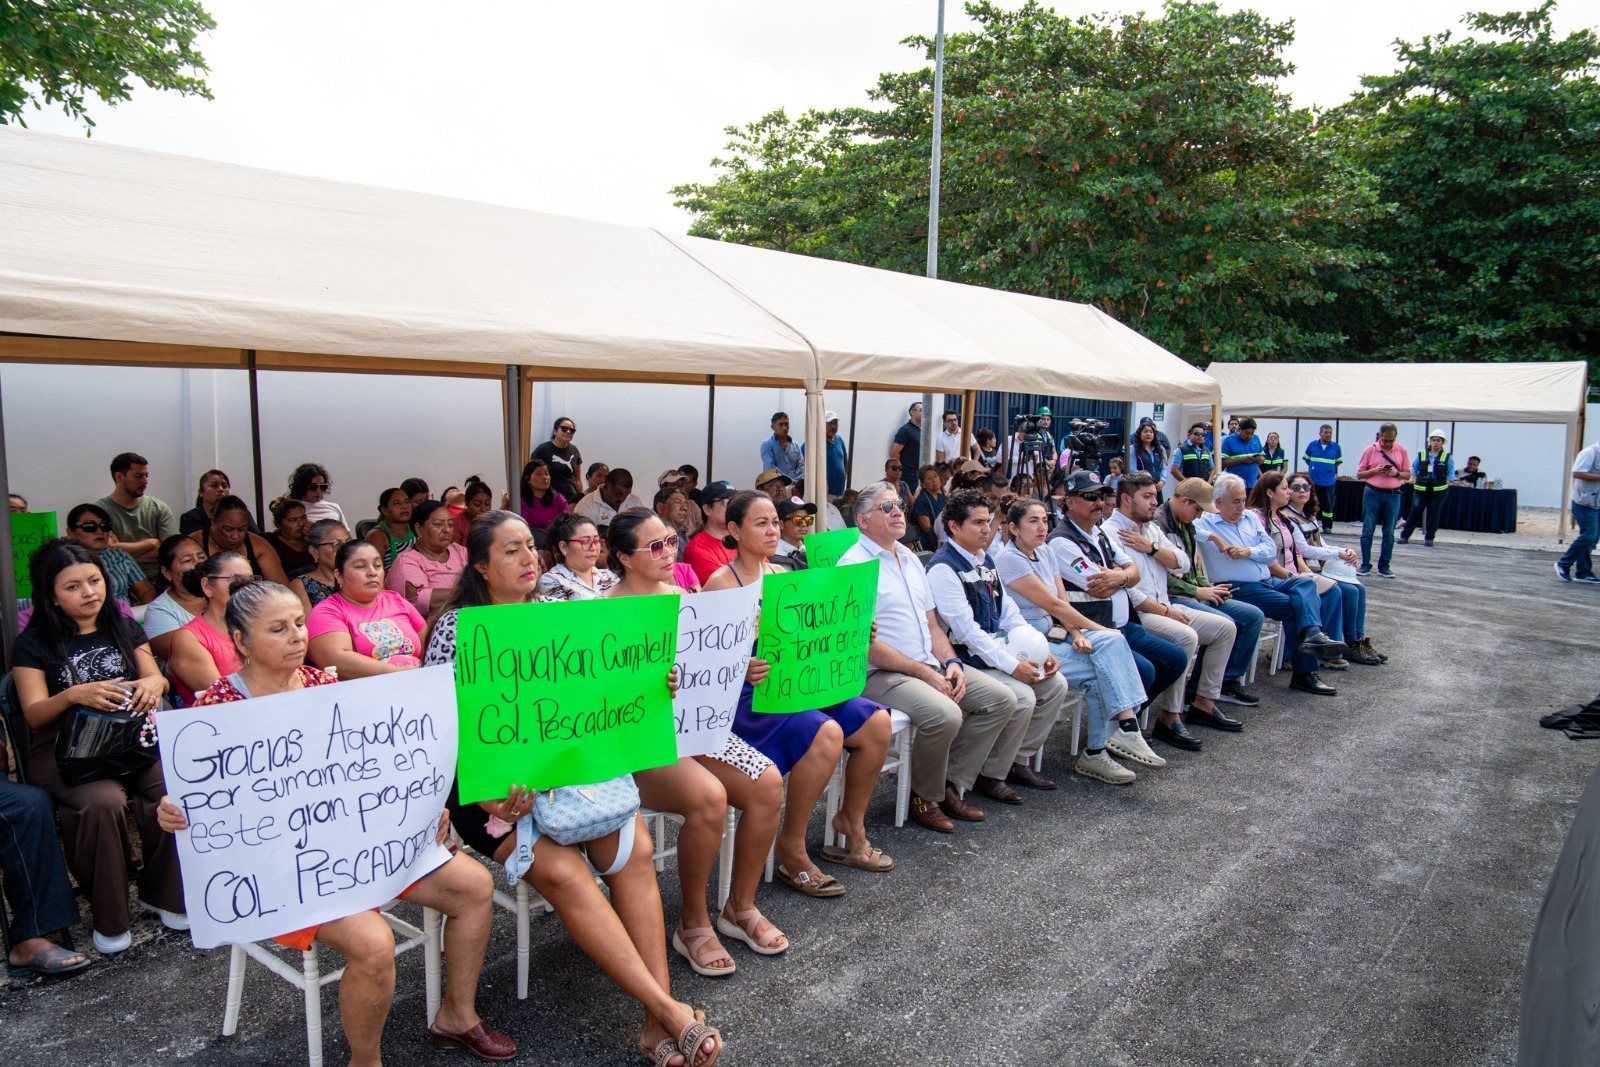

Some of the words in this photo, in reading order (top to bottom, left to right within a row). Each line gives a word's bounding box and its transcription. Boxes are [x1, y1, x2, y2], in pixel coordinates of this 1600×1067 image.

[601, 631, 673, 675] Cumple!!
[676, 605, 749, 653] Gracias
[760, 633, 786, 665] Por
[790, 632, 832, 662] tomar
[777, 668, 792, 700] la
[532, 695, 648, 743] Pescadores
[172, 720, 304, 783] Gracias
[180, 785, 241, 827] por
[394, 748, 431, 772] en
[190, 813, 282, 854] este
[288, 796, 350, 849] gran
[358, 766, 446, 833] proyecto
